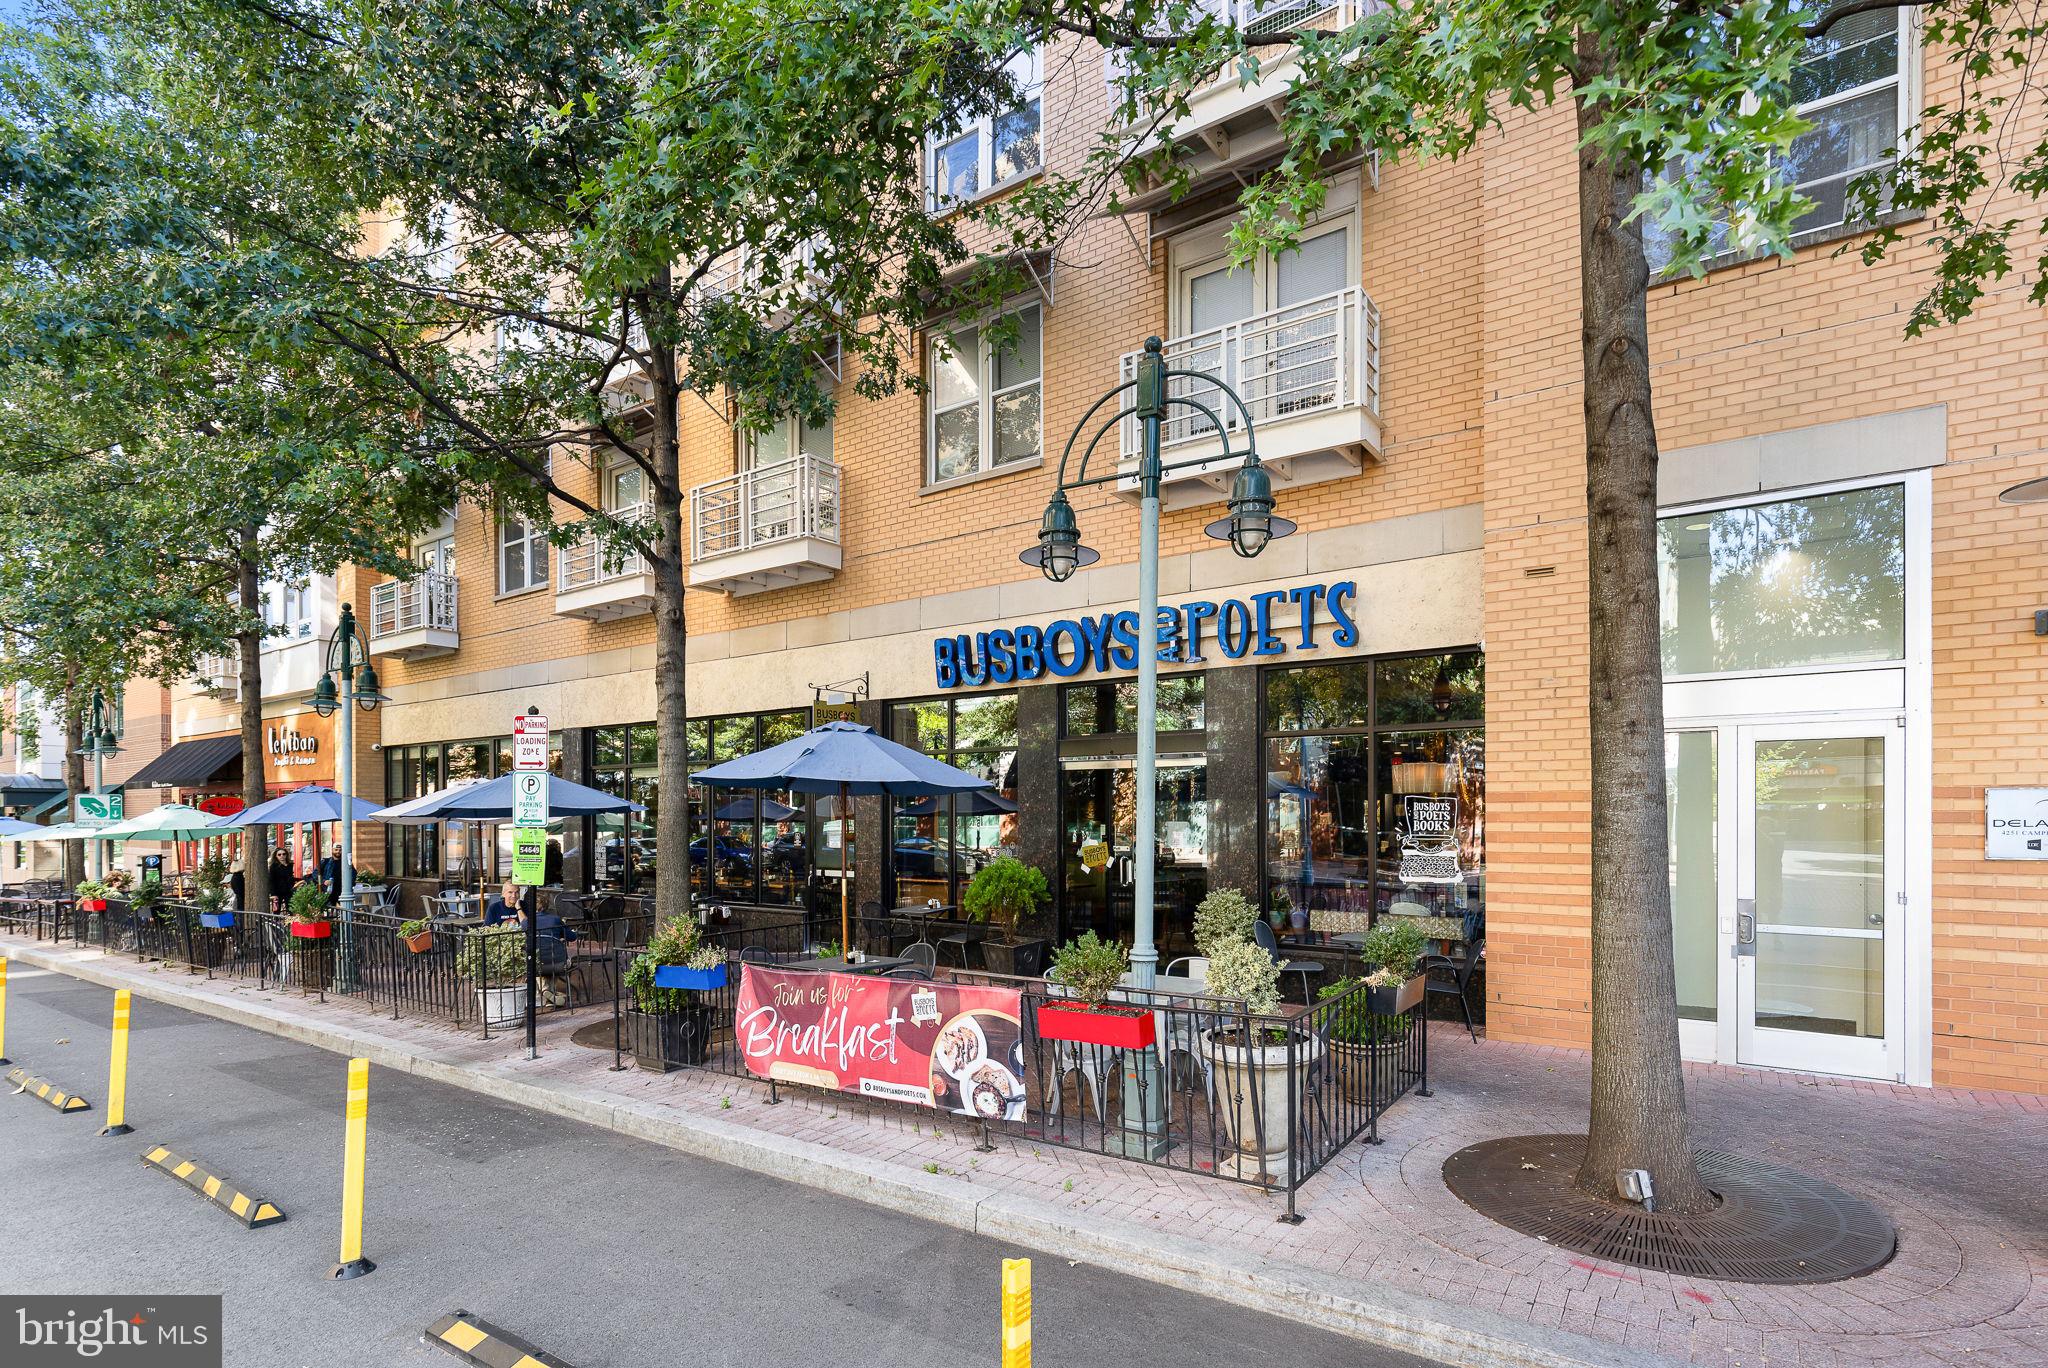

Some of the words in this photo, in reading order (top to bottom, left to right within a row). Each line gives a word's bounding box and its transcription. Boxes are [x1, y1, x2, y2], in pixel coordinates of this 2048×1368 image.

[934, 610, 1140, 688] BUSBOYS
[1180, 581, 1359, 663] POETS
[515, 719, 524, 730] NO
[525, 721, 547, 729] PARKING
[267, 724, 316, 755] Ichiban
[516, 737, 546, 745] LOADING
[528, 778, 535, 792] P
[111, 796, 121, 806] 2
[1413, 801, 1451, 811] BUSBOYS
[523, 808, 529, 818] 2
[1419, 810, 1451, 820] POETS
[1413, 820, 1450, 831] BOOKS
[773, 982, 805, 1008] Join
[810, 987, 828, 1005] us
[832, 978, 854, 1009] for
[740, 1006, 905, 1072] Breakfast
